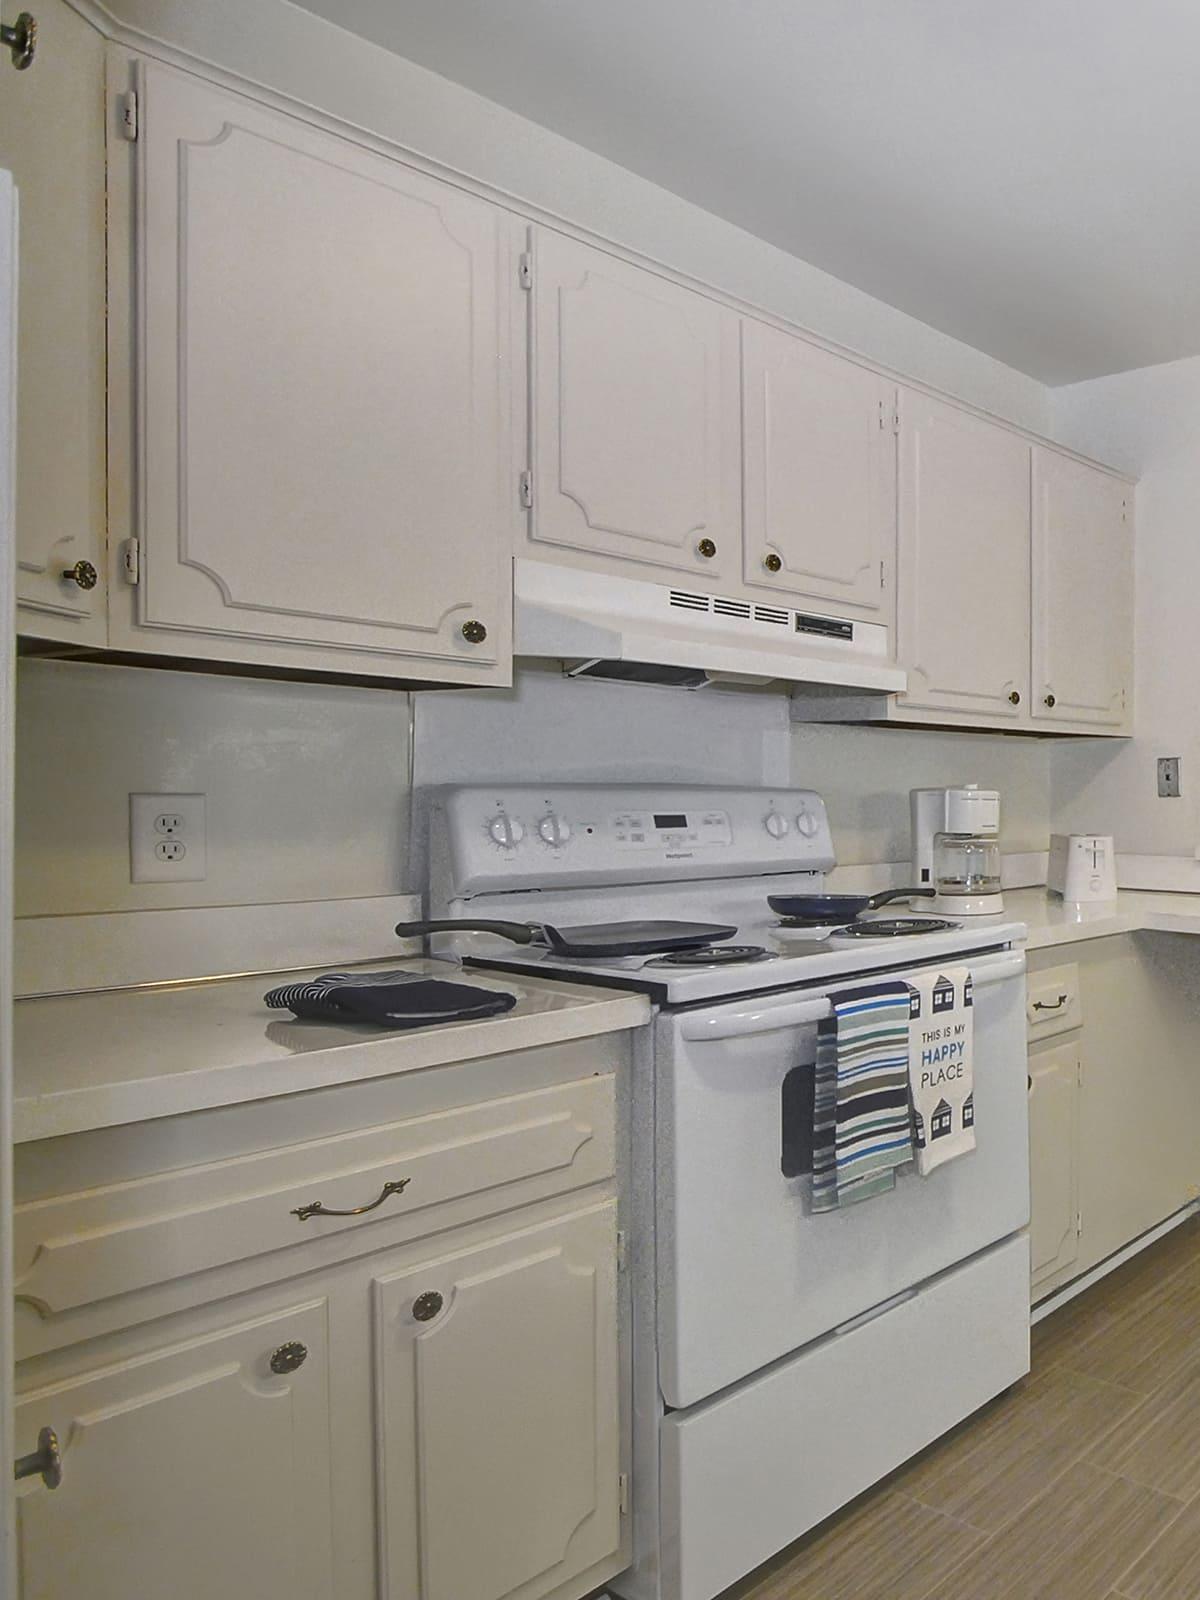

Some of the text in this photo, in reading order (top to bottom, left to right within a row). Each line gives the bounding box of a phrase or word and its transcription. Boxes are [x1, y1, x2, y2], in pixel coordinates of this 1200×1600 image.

[921, 1023, 965, 1043] THIS IS MY
[921, 1041, 965, 1067] HAPPY
[921, 1062, 964, 1089] PLACE
